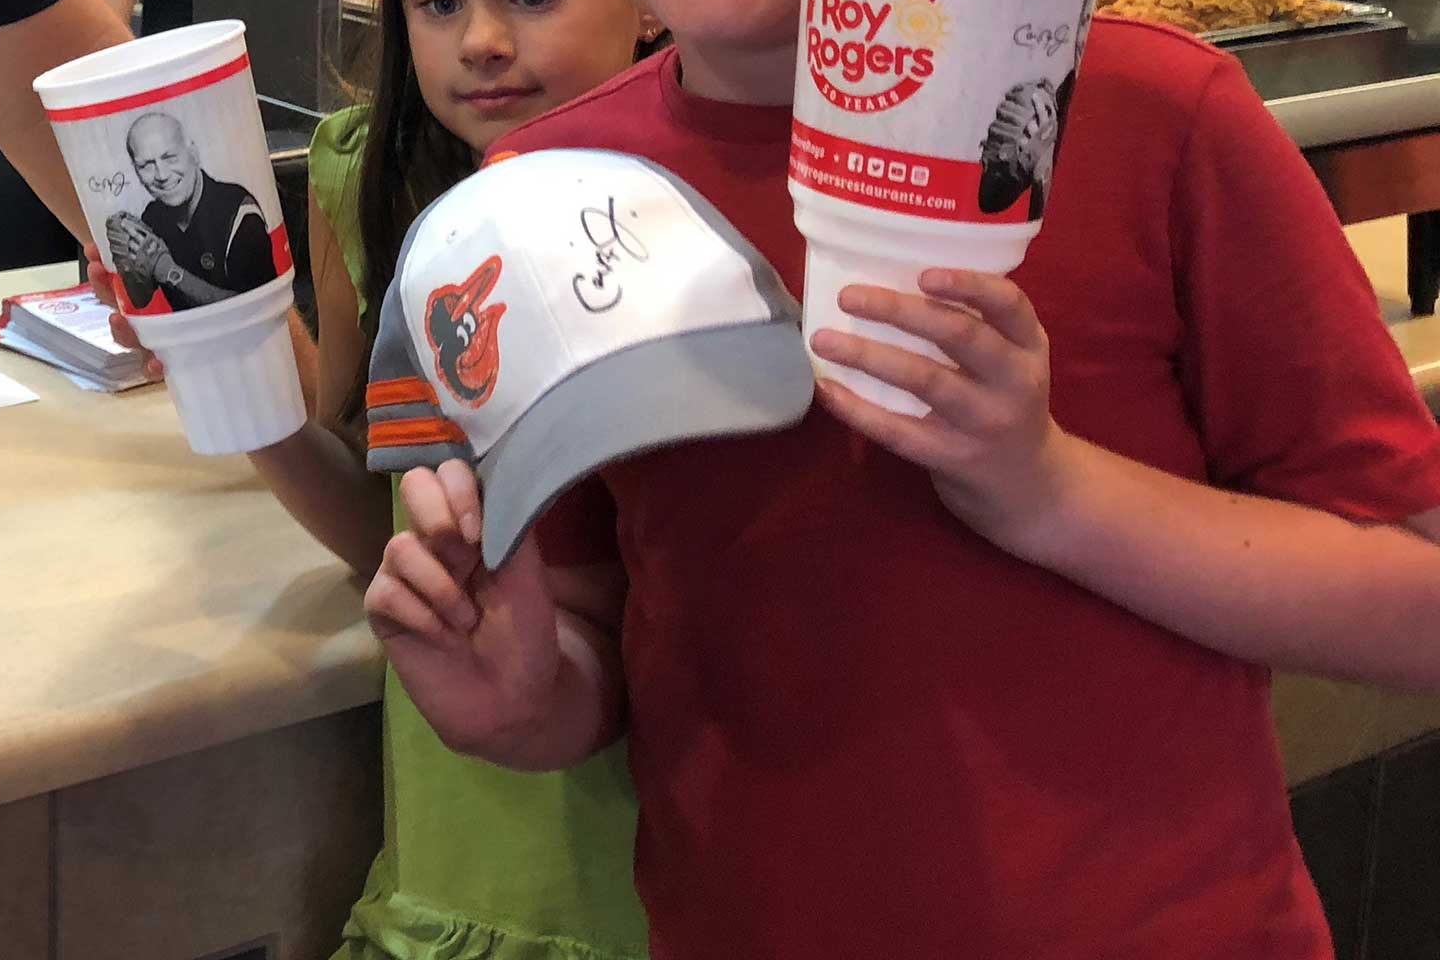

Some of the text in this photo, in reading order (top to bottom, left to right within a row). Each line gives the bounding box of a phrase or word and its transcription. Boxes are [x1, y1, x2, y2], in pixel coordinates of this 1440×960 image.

[807, 26, 934, 83] Rogers
[821, 83, 899, 111] 50 YEARS
